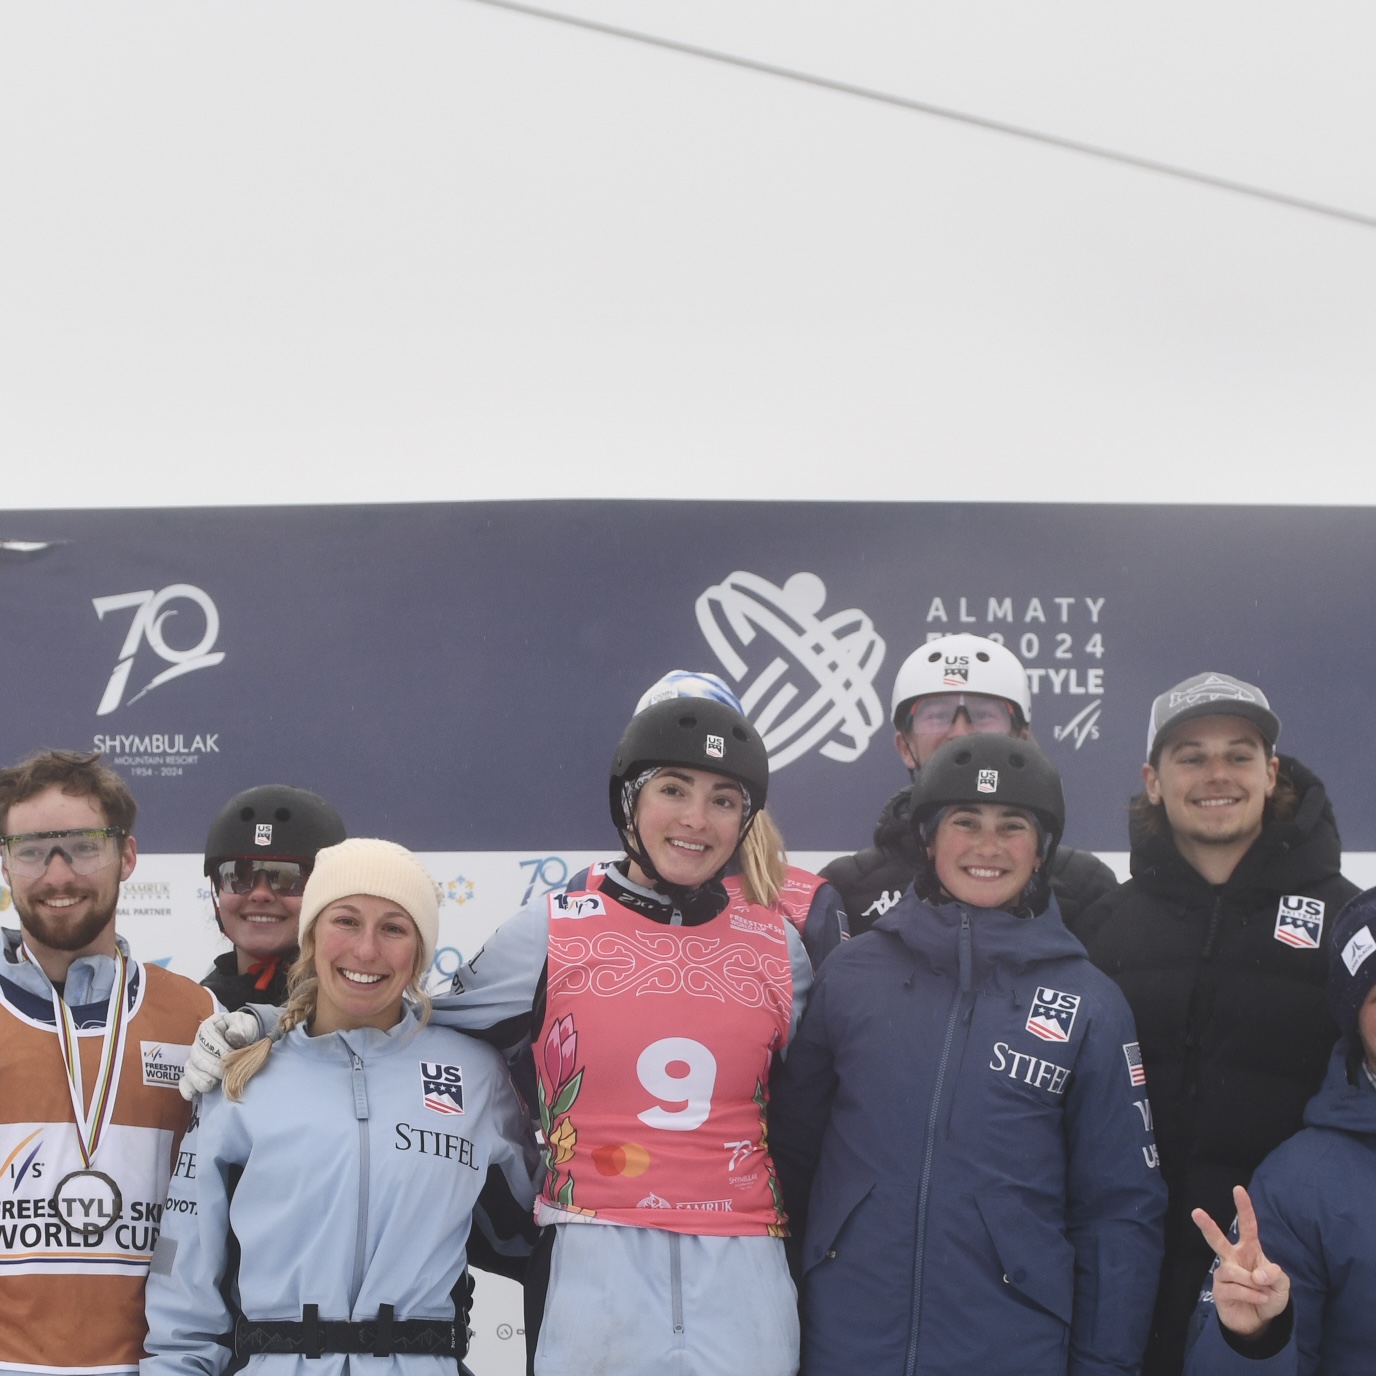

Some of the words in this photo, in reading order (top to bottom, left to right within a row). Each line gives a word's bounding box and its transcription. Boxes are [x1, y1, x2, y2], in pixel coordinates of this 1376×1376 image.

[926, 597, 1105, 623] ALMATY
[944, 655, 969, 665] US
[1026, 668, 1104, 694] TYLE
[93, 734, 219, 753] SHYMBULAK
[708, 736, 723, 746] US
[980, 771, 995, 779] US
[1283, 897, 1321, 916] US
[1036, 988, 1082, 1010] US
[145, 1069, 180, 1081] WORLD
[420, 1062, 462, 1083] US
[989, 1042, 1071, 1094] STIFEL
[636, 1037, 717, 1131] 9
[395, 1122, 479, 1171] STIFEL
[131, 1201, 161, 1223] SKI
